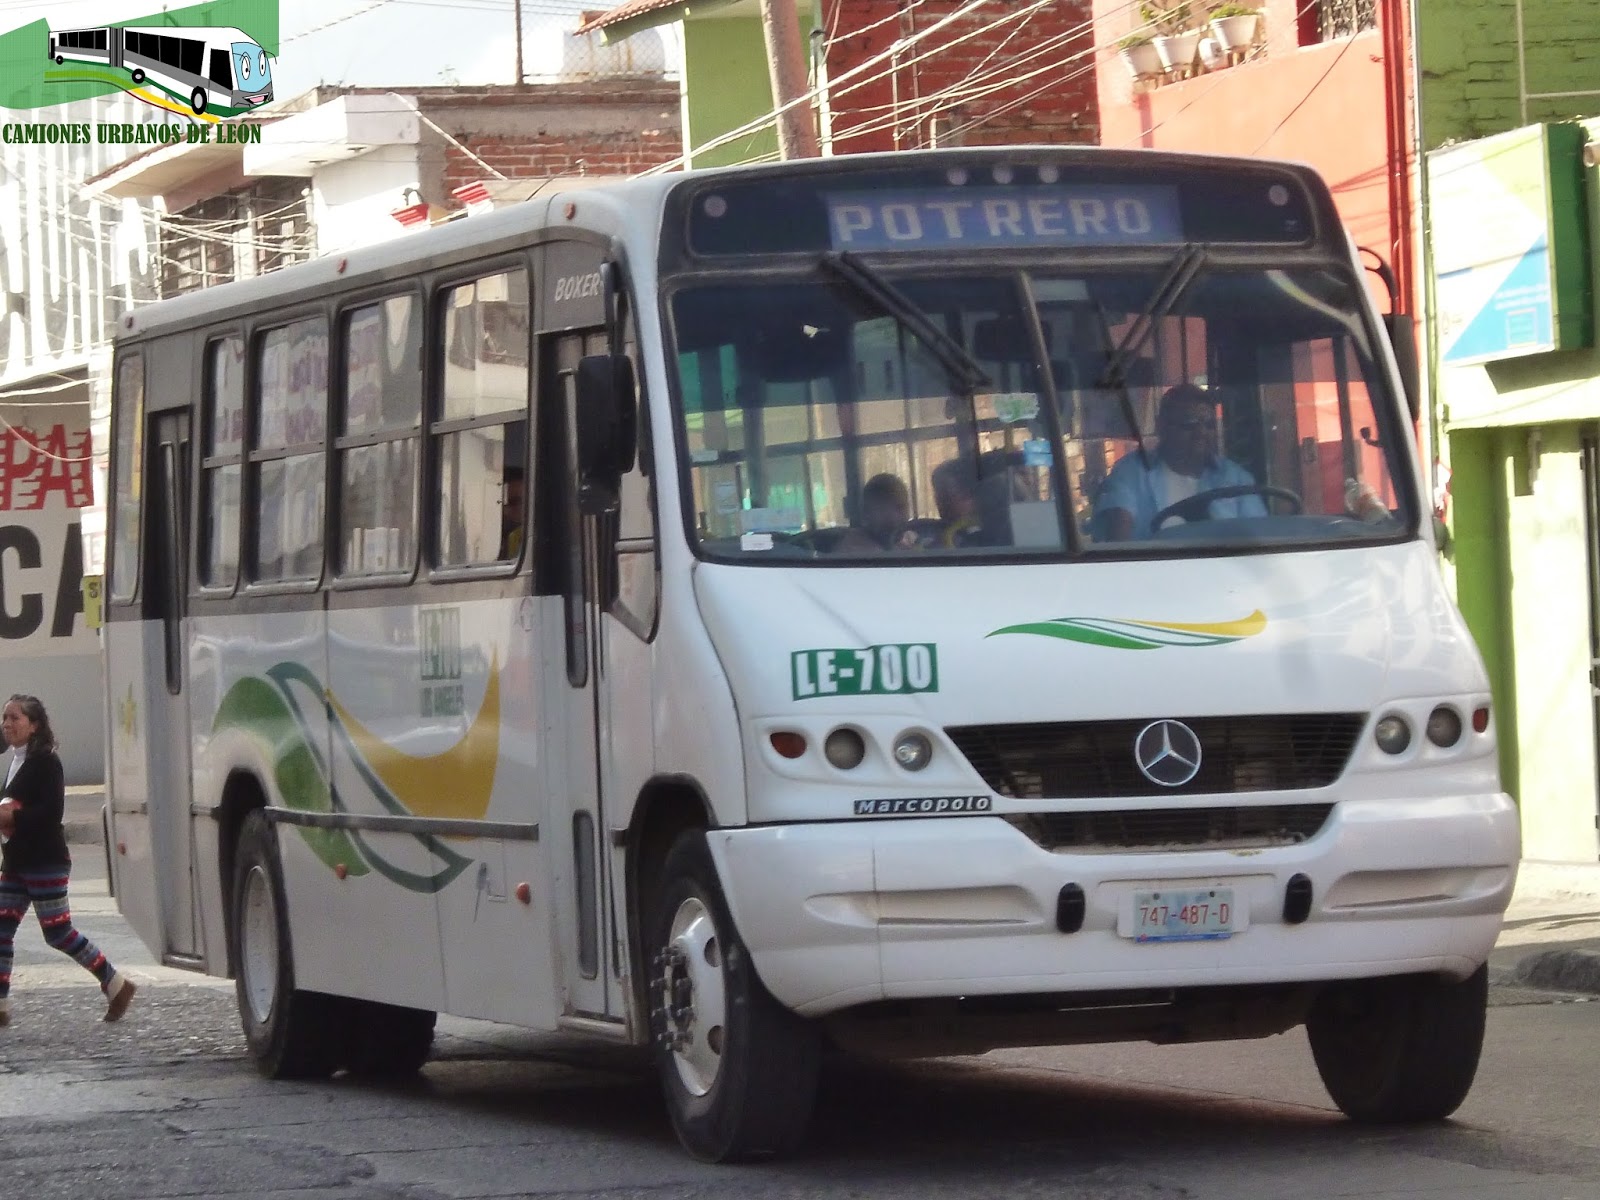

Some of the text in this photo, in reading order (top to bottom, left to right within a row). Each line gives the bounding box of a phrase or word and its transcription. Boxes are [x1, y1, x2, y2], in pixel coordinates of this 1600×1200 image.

[833, 199, 1151, 241] POTRERO
[555, 272, 600, 302] BOXER
[795, 643, 933, 697] LE-700
